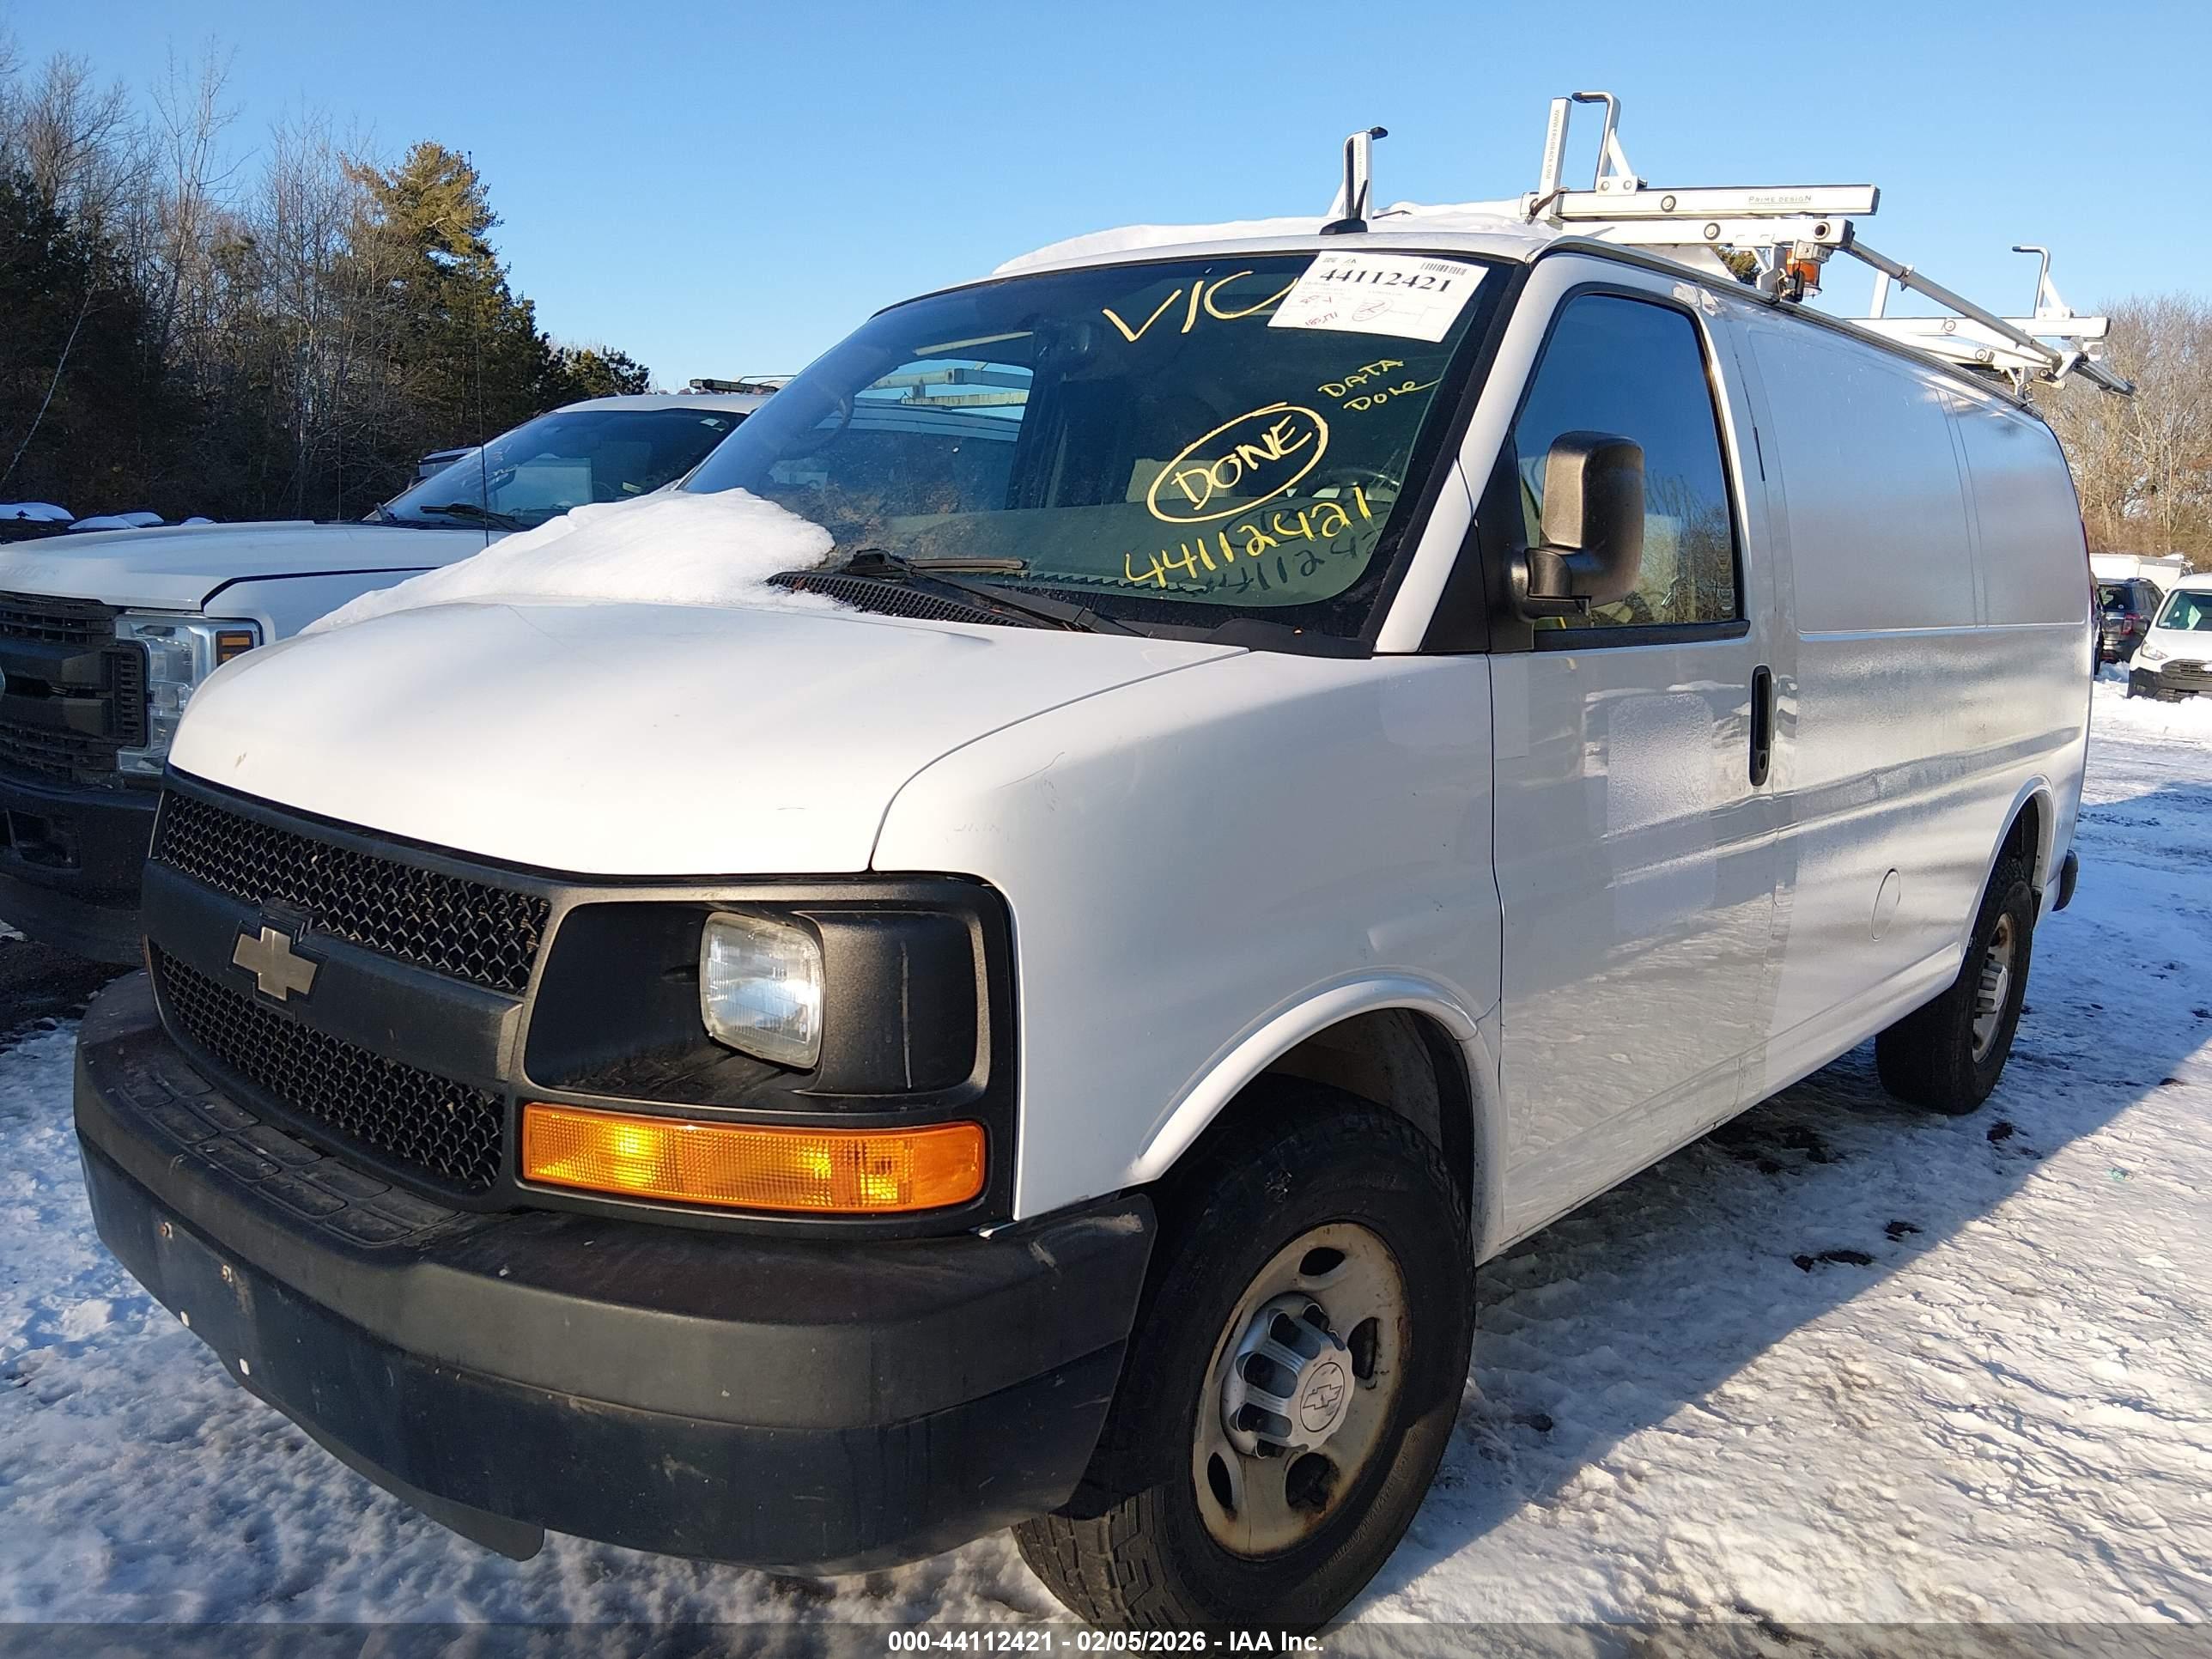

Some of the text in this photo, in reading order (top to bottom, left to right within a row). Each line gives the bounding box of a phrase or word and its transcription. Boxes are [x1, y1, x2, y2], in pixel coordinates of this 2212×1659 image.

[1319, 268, 1452, 293] 44112421
[1317, 359, 1403, 398] DATA
[1170, 415, 1312, 510] DONE
[1125, 486, 1372, 587] 44112421
